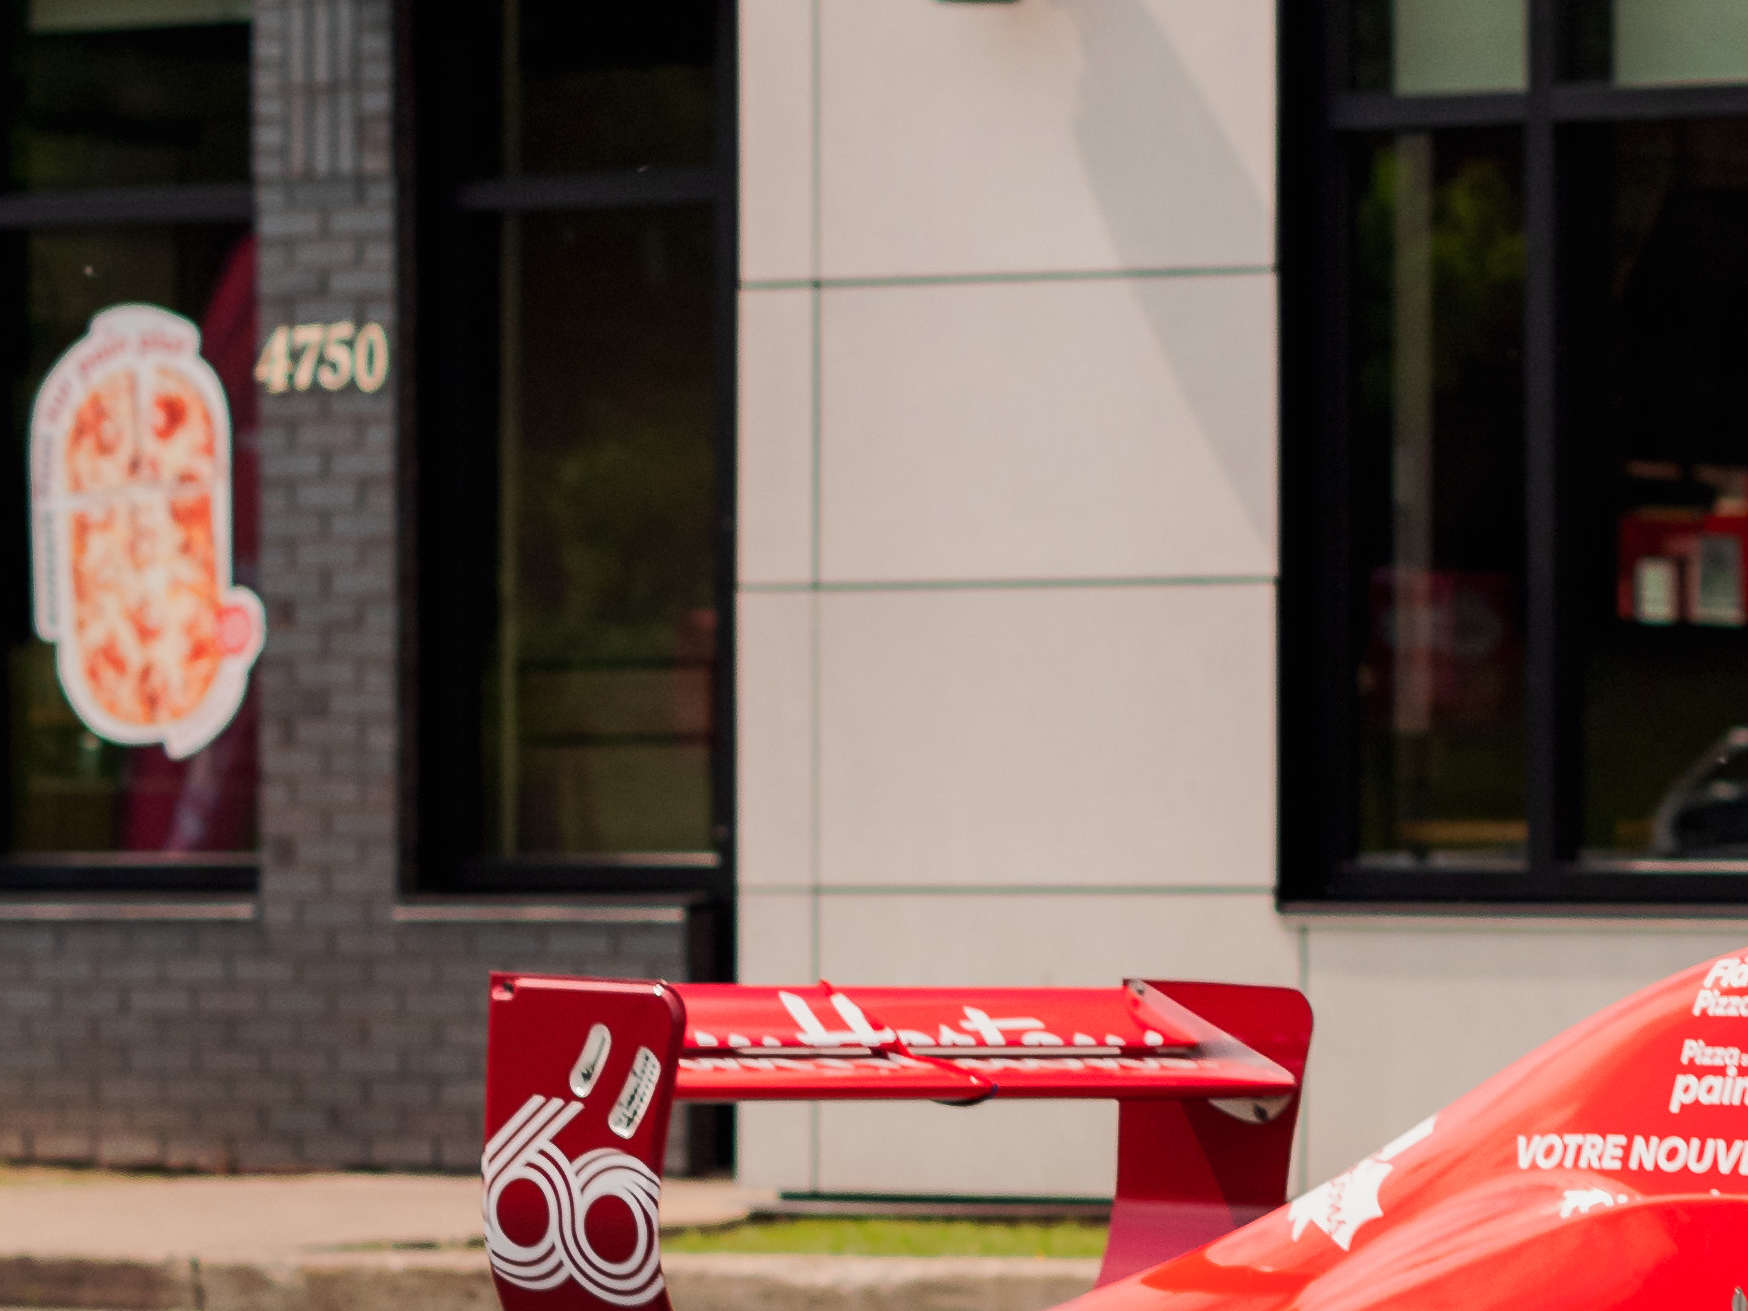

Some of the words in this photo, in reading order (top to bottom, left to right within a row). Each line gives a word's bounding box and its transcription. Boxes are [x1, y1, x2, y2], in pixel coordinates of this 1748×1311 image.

[256, 321, 389, 393] 4750
[1680, 1038, 1741, 1066] Pizza
[1516, 1133, 1628, 1171] VOTRE
[481, 1094, 665, 1308] 60
